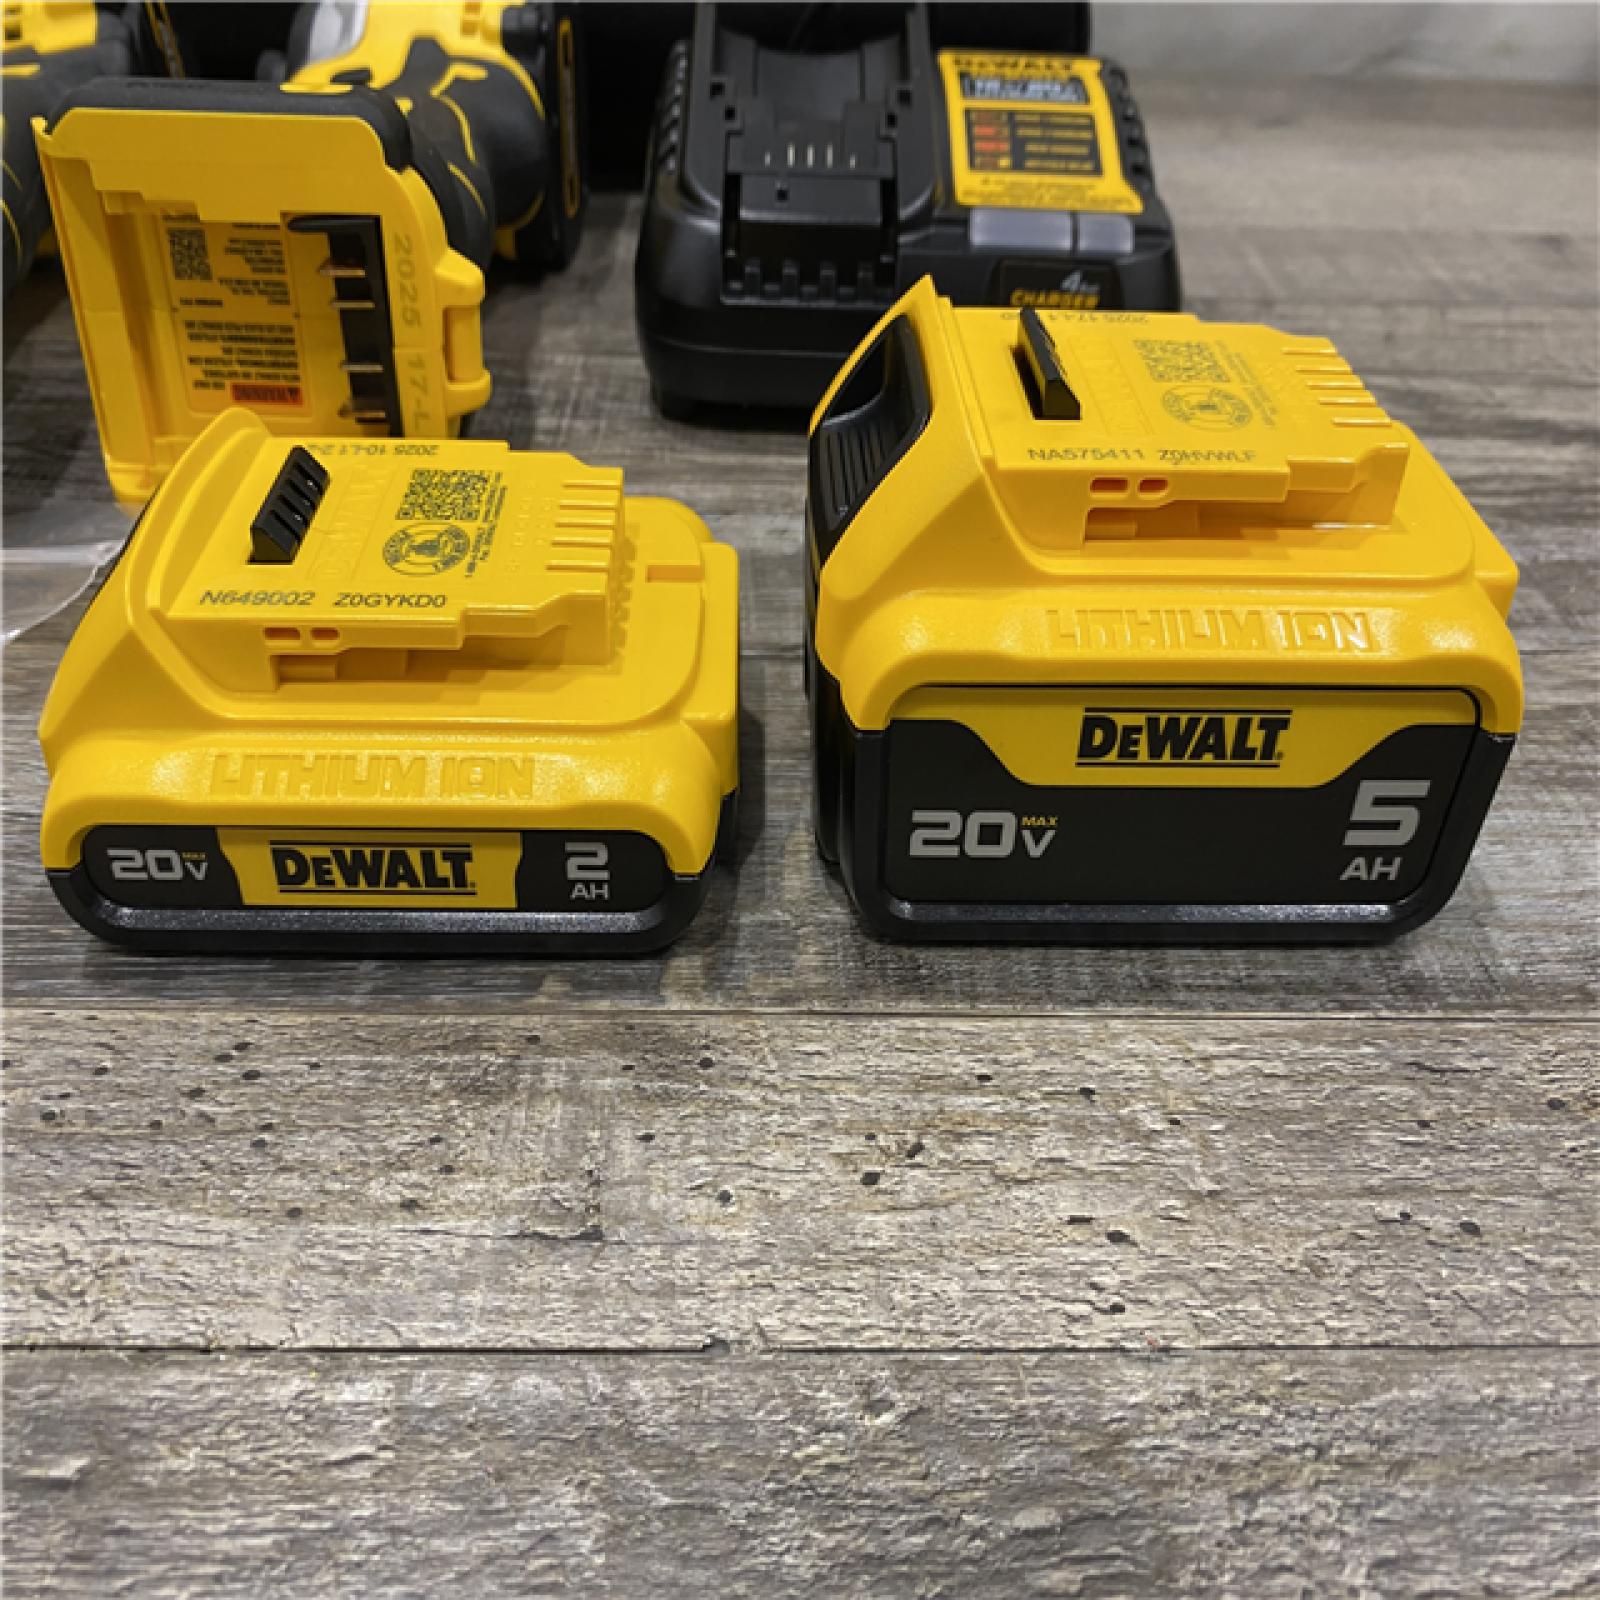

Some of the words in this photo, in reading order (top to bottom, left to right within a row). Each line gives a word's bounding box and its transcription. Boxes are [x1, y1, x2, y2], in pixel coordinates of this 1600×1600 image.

[395, 234, 421, 326] 2025
[1047, 609, 1266, 651] LITHIUM
[1276, 612, 1374, 652] ION
[1076, 715, 1288, 761] DEWALT
[209, 753, 432, 798] LITHIUM
[439, 756, 535, 800] ION
[1022, 816, 1058, 826] MAX
[1342, 779, 1431, 847] 5
[270, 847, 474, 890] DEWALT
[564, 842, 610, 881] 2
[1338, 857, 1403, 881] AH
[569, 883, 610, 899] AH
